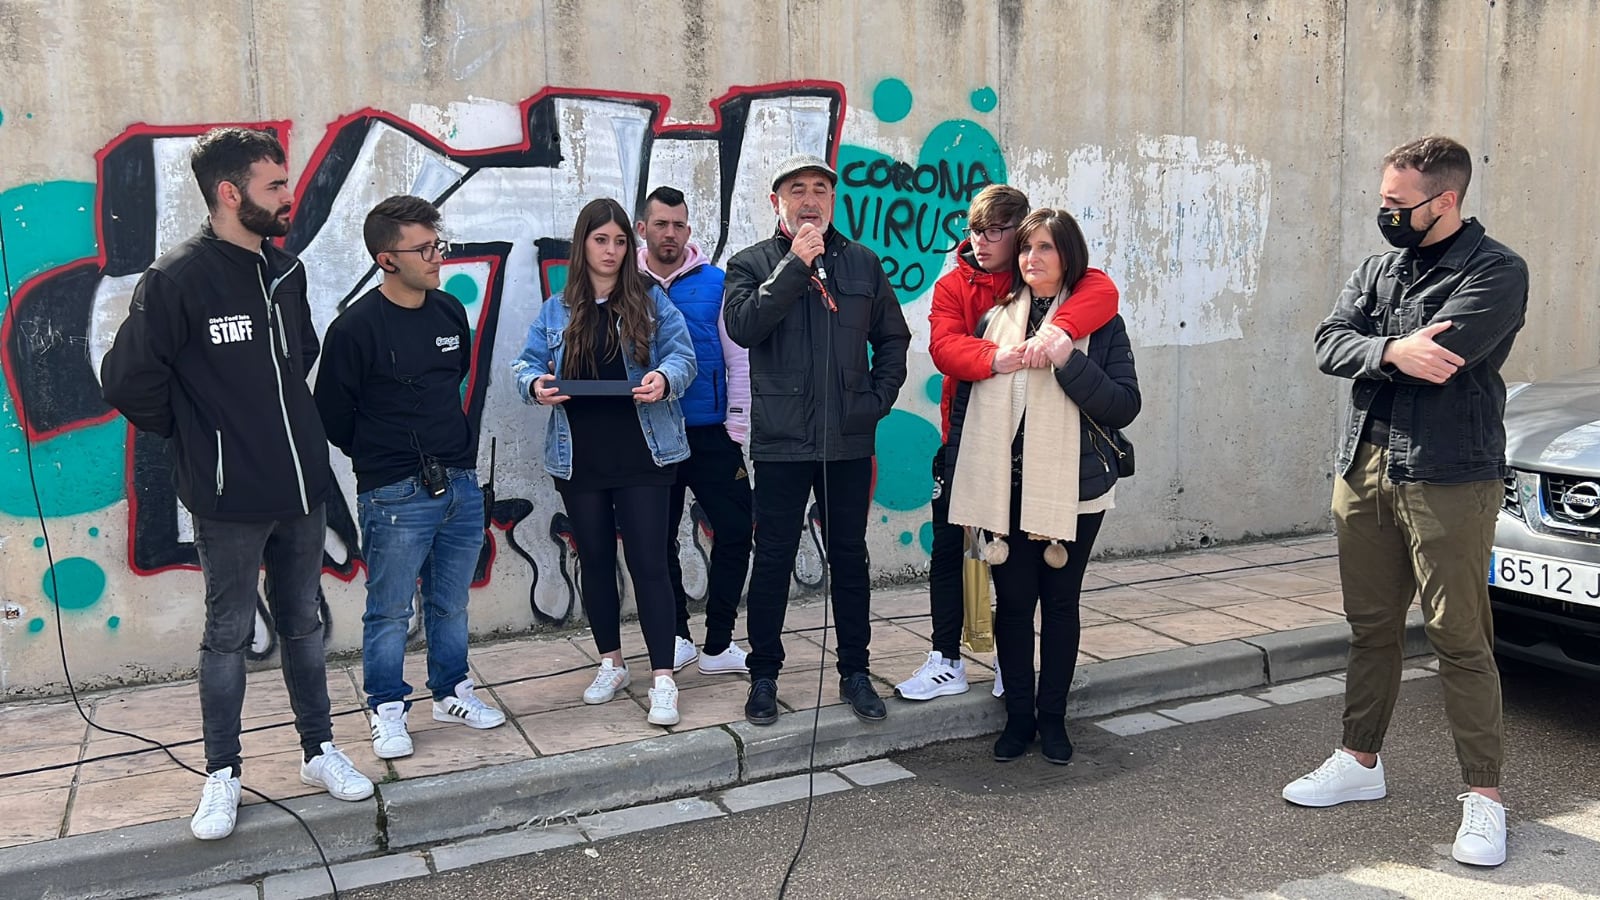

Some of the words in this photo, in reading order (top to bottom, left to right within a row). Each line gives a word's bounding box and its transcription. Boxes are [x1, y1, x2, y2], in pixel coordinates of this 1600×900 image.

[842, 159, 993, 203] CORONA
[844, 194, 967, 254] VIRUS
[209, 320, 253, 345] STAFF
[1564, 493, 1600, 507] NISSAN
[1500, 557, 1573, 595] 6512
